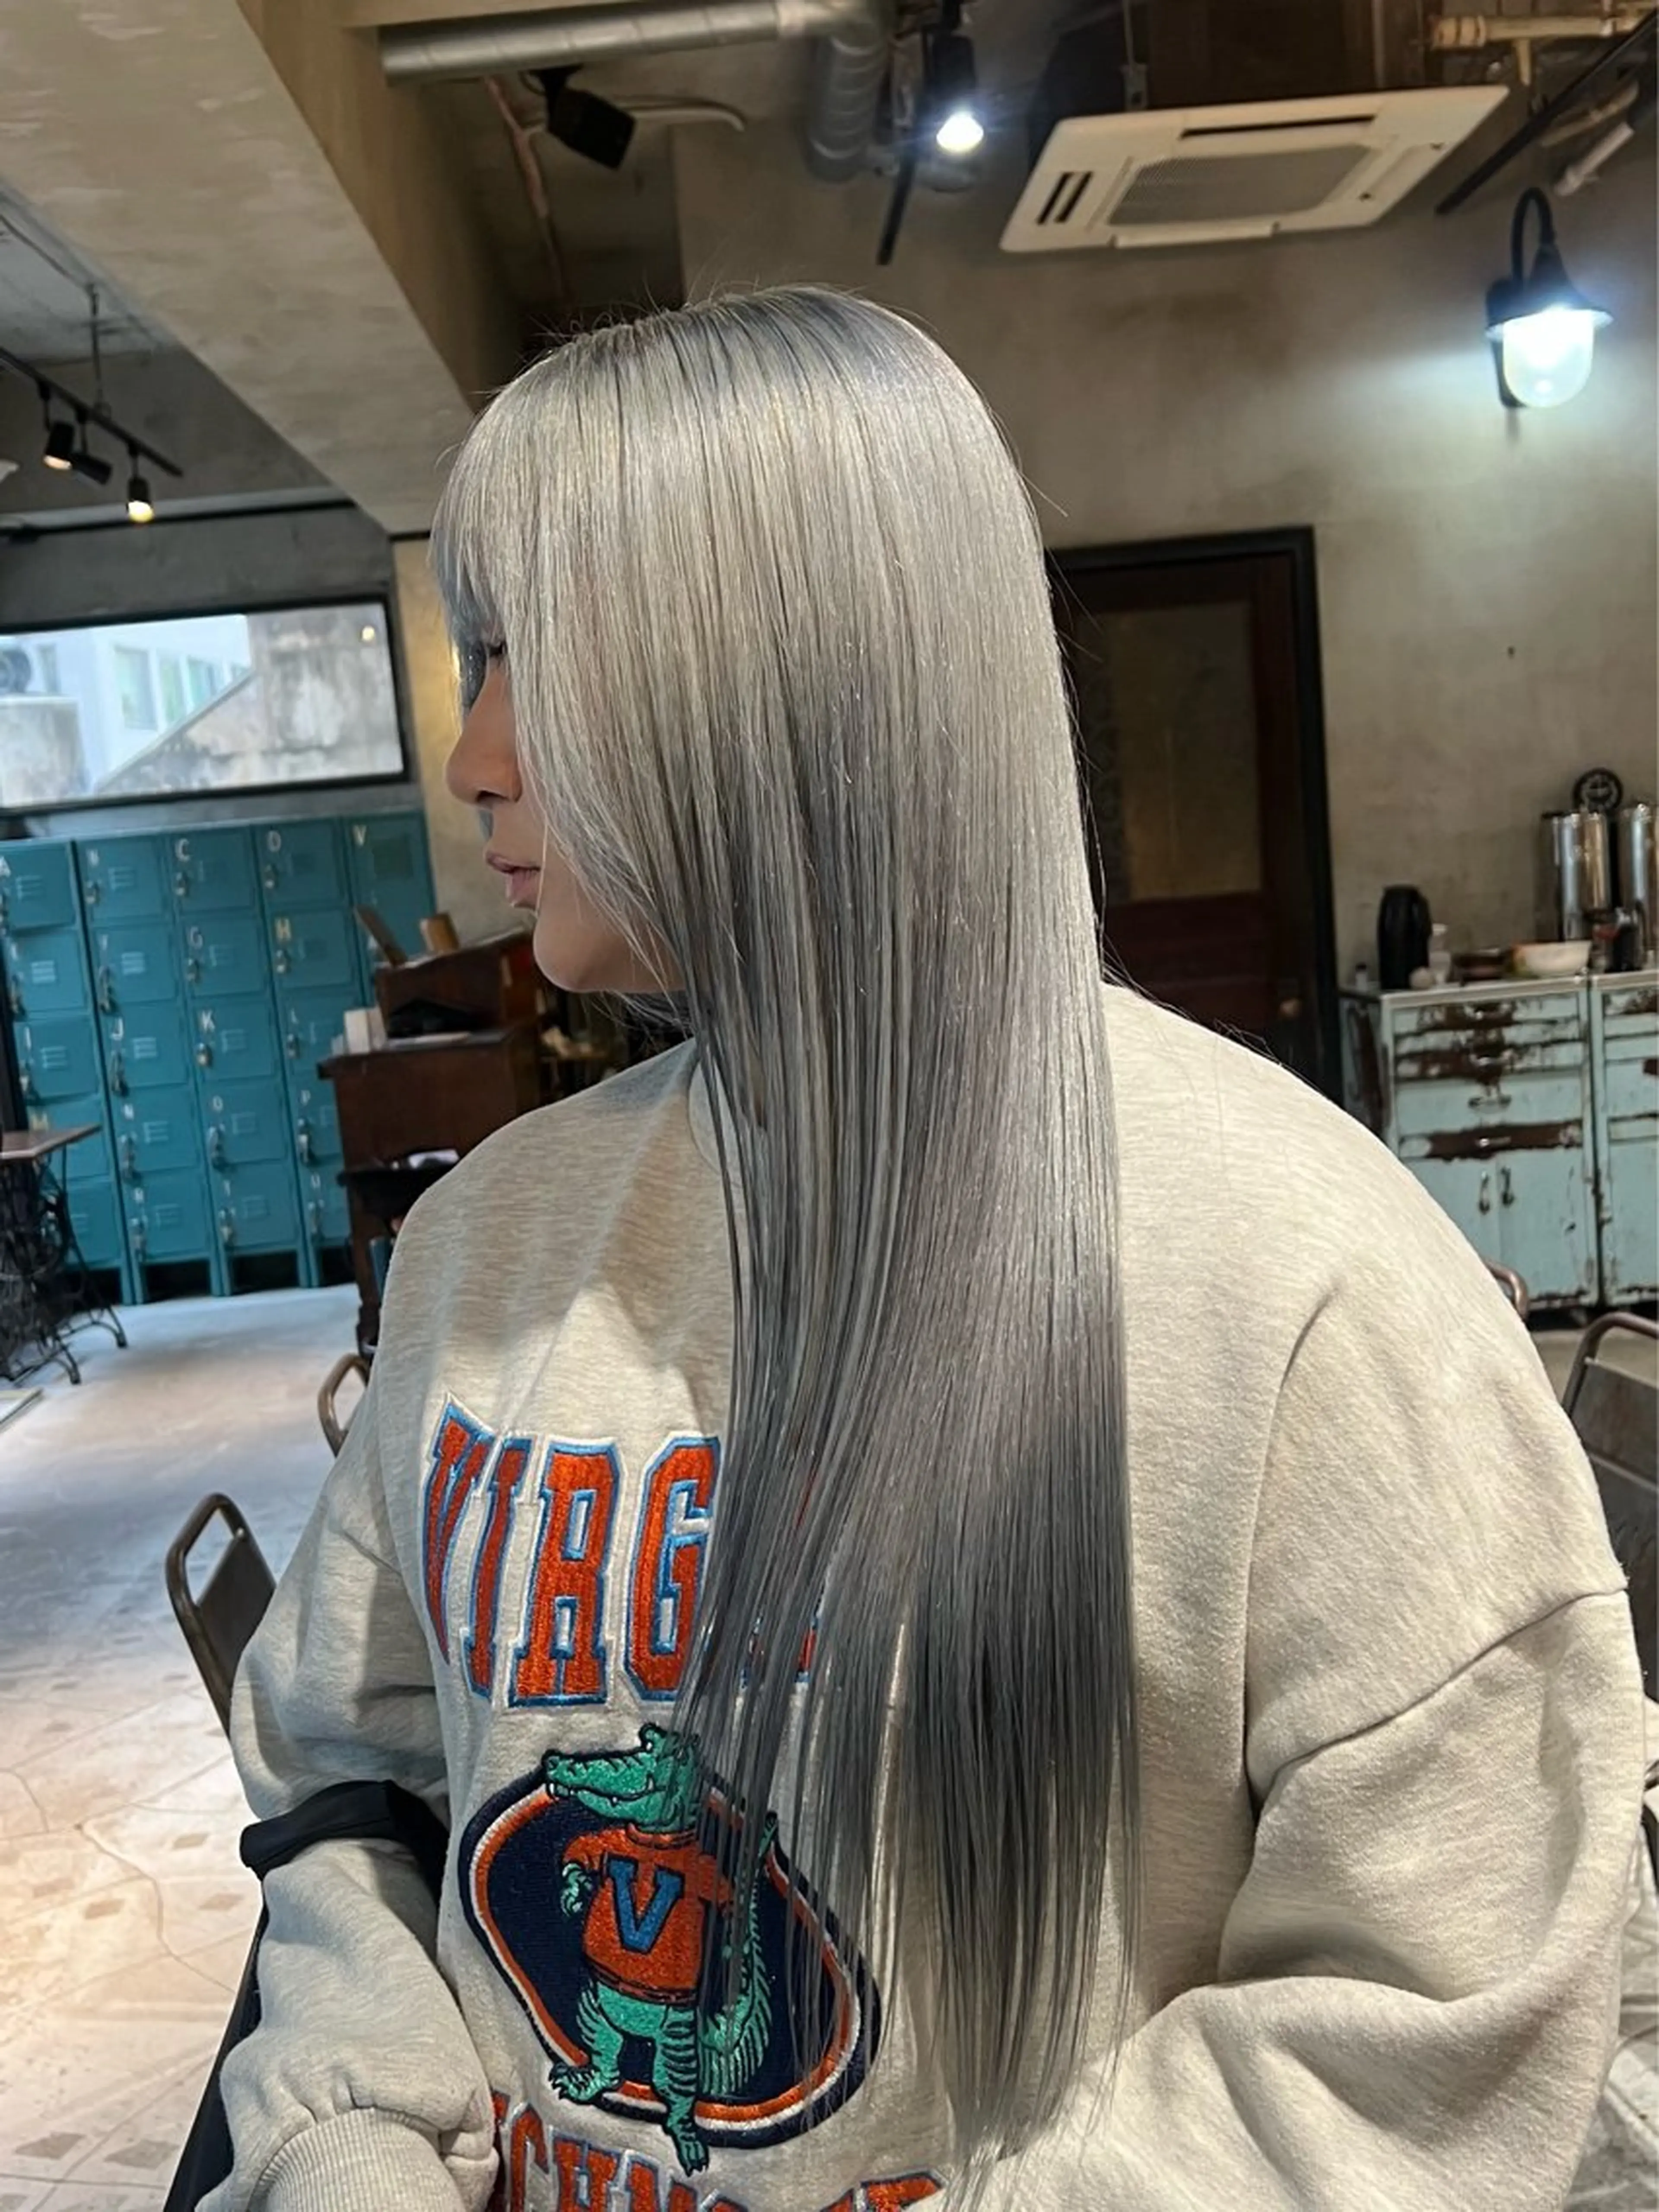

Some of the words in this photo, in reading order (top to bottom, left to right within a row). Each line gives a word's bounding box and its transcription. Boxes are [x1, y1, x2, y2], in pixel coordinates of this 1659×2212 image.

[352, 824, 367, 847] V
[175, 837, 190, 862] C
[188, 926, 203, 950] G
[274, 917, 292, 942] H
[111, 1017, 124, 1040] J
[201, 1009, 215, 1032] K
[420, 1394, 727, 1708] VIRG
[604, 1853, 685, 1954] V
